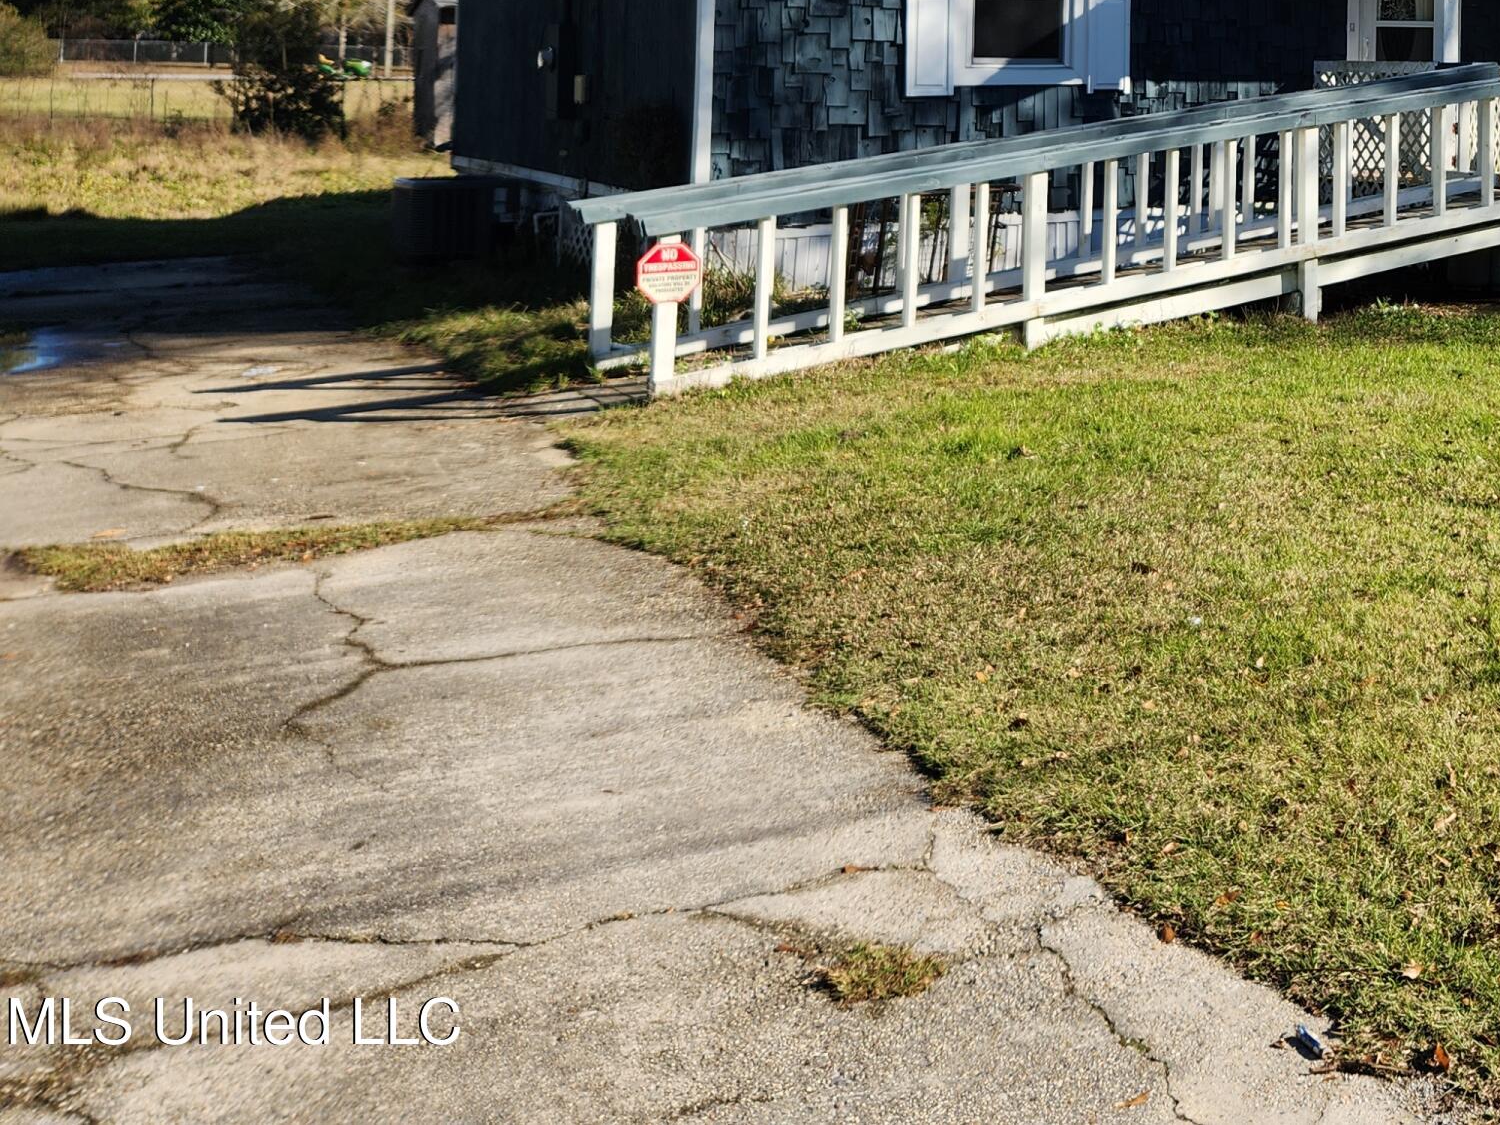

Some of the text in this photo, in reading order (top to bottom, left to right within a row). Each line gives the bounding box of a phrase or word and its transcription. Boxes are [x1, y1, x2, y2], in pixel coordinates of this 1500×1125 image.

[661, 248, 678, 261] NO
[643, 262, 696, 272] TRESPASSING
[642, 273, 697, 283] PRIVATE PROPERTY
